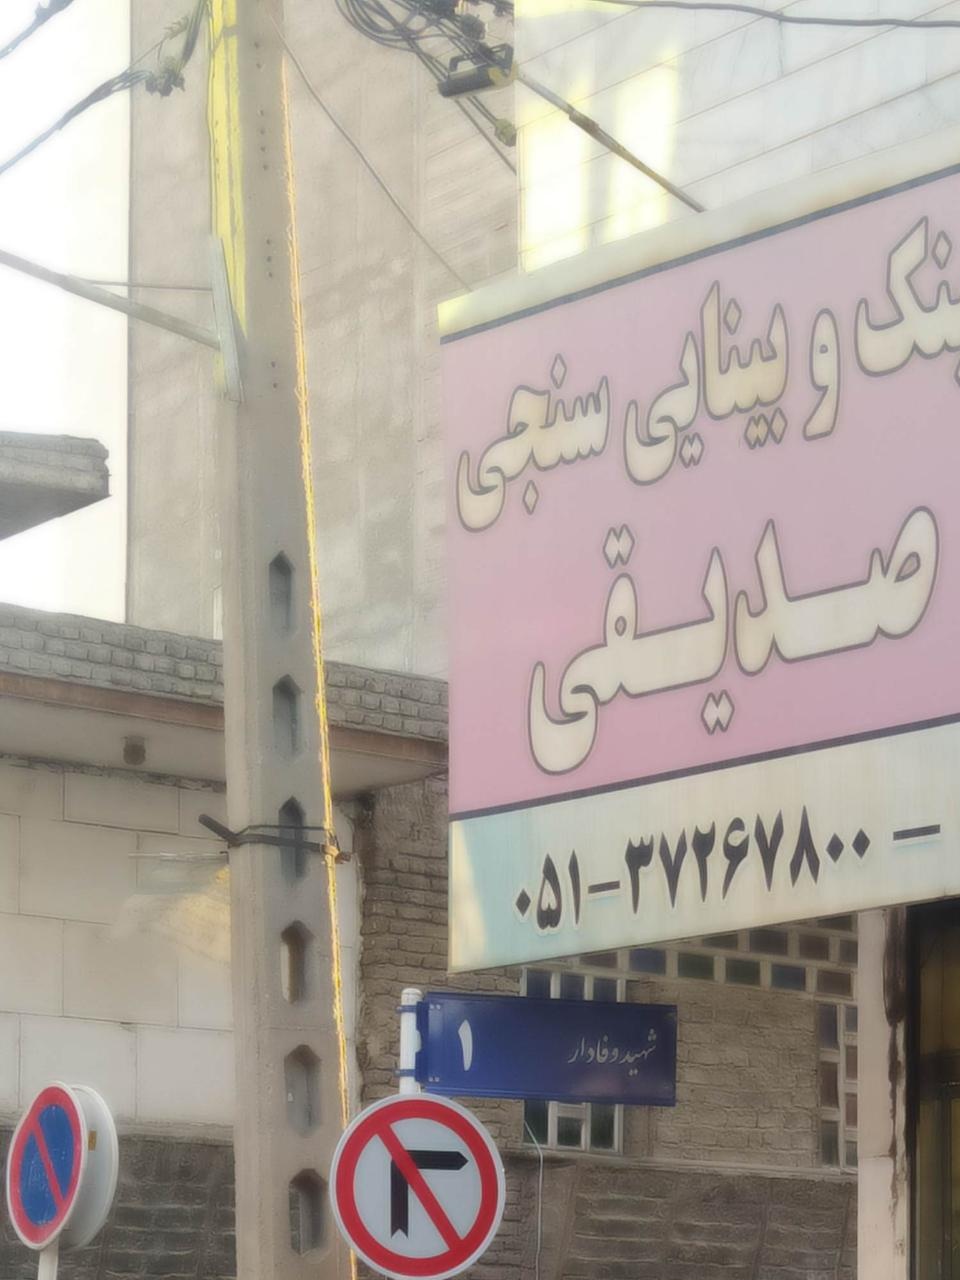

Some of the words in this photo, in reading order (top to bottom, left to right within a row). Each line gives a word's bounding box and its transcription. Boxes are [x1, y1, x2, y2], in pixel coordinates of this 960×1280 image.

[623, 280, 790, 486] بینایی
[803, 308, 842, 441] و
[456, 353, 610, 533] سنجی
[528, 505, 941, 775] صدیقی
[457, 1018, 473, 1072] ۱
[567, 1034, 620, 1065] وفادار
[619, 1028, 657, 1076] شهید
